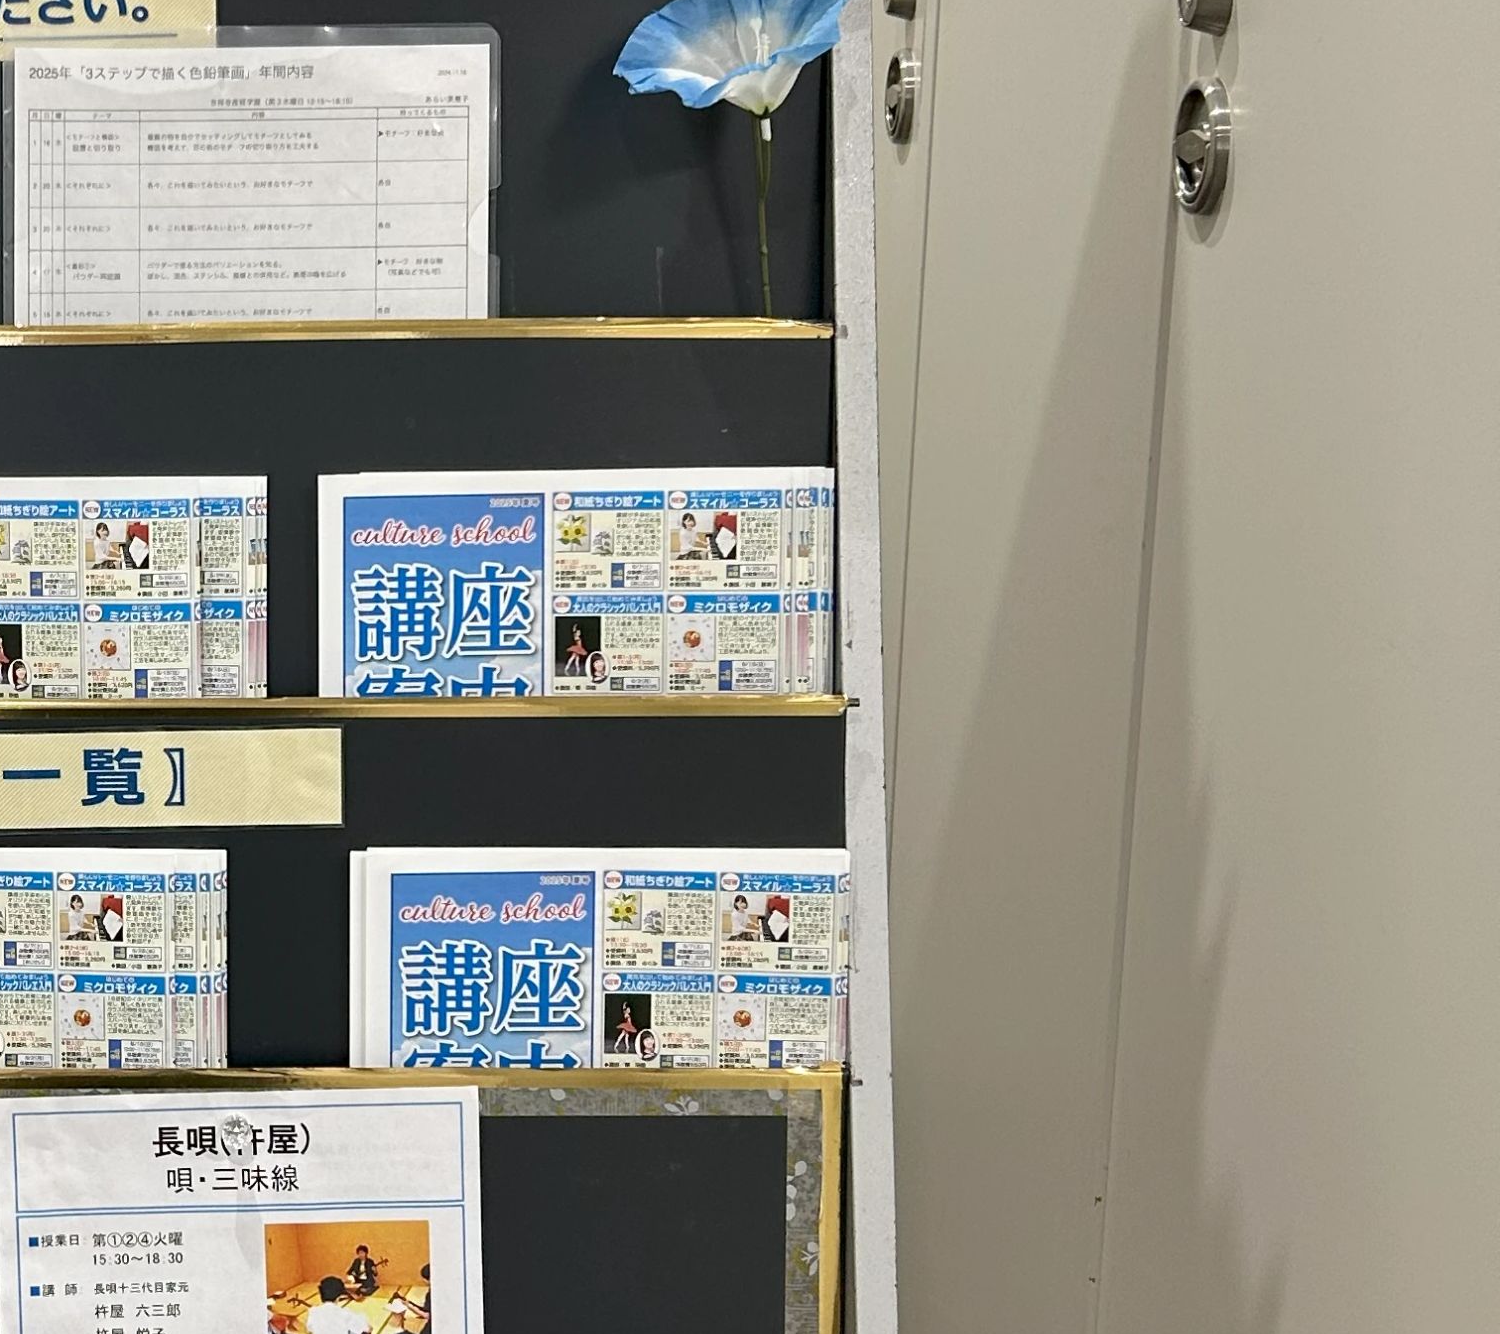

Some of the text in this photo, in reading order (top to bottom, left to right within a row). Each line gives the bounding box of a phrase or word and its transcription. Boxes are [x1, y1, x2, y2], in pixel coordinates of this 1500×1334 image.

[351, 514, 535, 546] culture school
[108, 610, 185, 621] ミクロモザイク
[350, 562, 535, 661] 講座
[693, 601, 772, 613] ミクロモザイク
[400, 892, 586, 922] culture school
[83, 982, 158, 994] ミクロモザイク
[399, 938, 585, 1037] 講座
[744, 982, 824, 994] ミクロモザイク
[165, 1165, 300, 1194] 唄・三味線
[94, 1303, 182, 1320] 杵屋 六三郎
